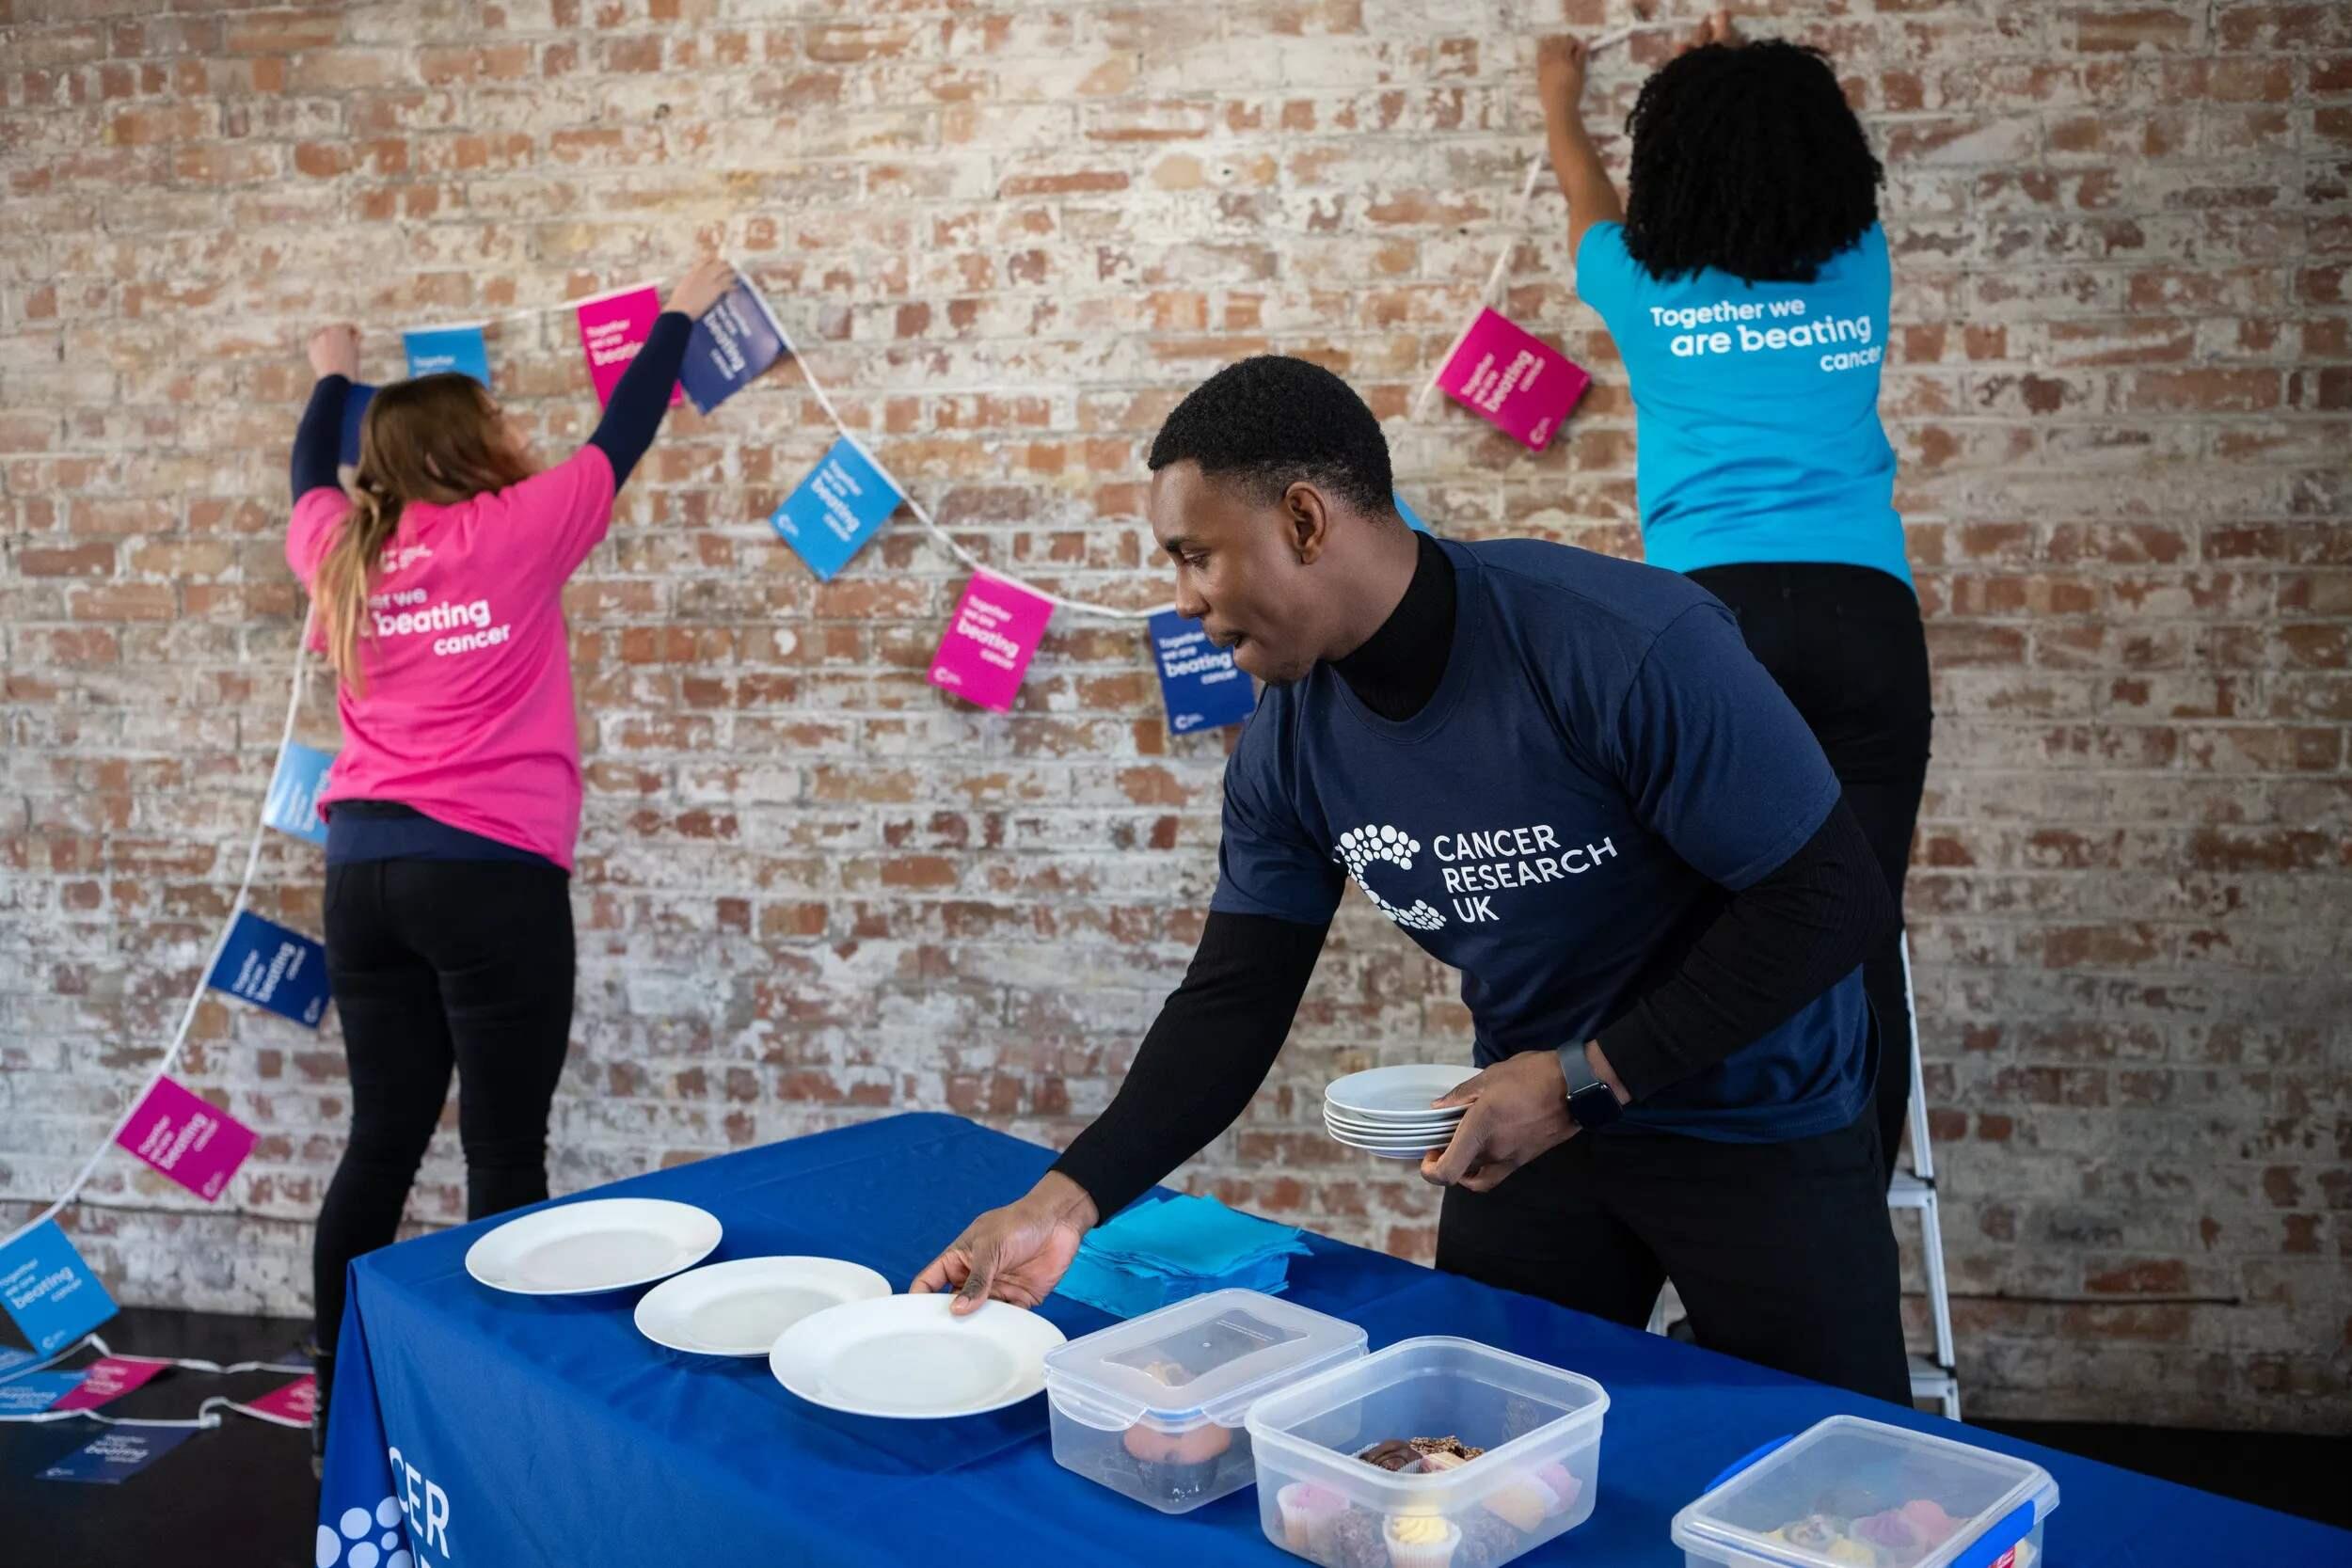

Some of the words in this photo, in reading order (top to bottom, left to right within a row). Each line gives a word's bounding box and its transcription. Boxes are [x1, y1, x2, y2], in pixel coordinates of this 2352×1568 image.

[1649, 300, 1765, 329] Together
[1769, 299, 1805, 317] we
[1670, 330, 1732, 357] are
[1737, 315, 1872, 353] beating
[1820, 345, 1883, 372] cancer
[1482, 349, 1535, 414] beating
[810, 476, 861, 534] beating
[393, 588, 428, 607] we
[372, 599, 491, 638] beating
[956, 616, 1020, 659] beating
[434, 624, 511, 656] cancer
[1164, 652, 1234, 678] beating
[1433, 824, 1562, 863] CANCER
[1441, 836, 1618, 895] RESEARCH
[1453, 895, 1500, 924] UK
[254, 941, 296, 1003] beating
[158, 1112, 209, 1170] beating
[10, 1266, 74, 1310] beating
